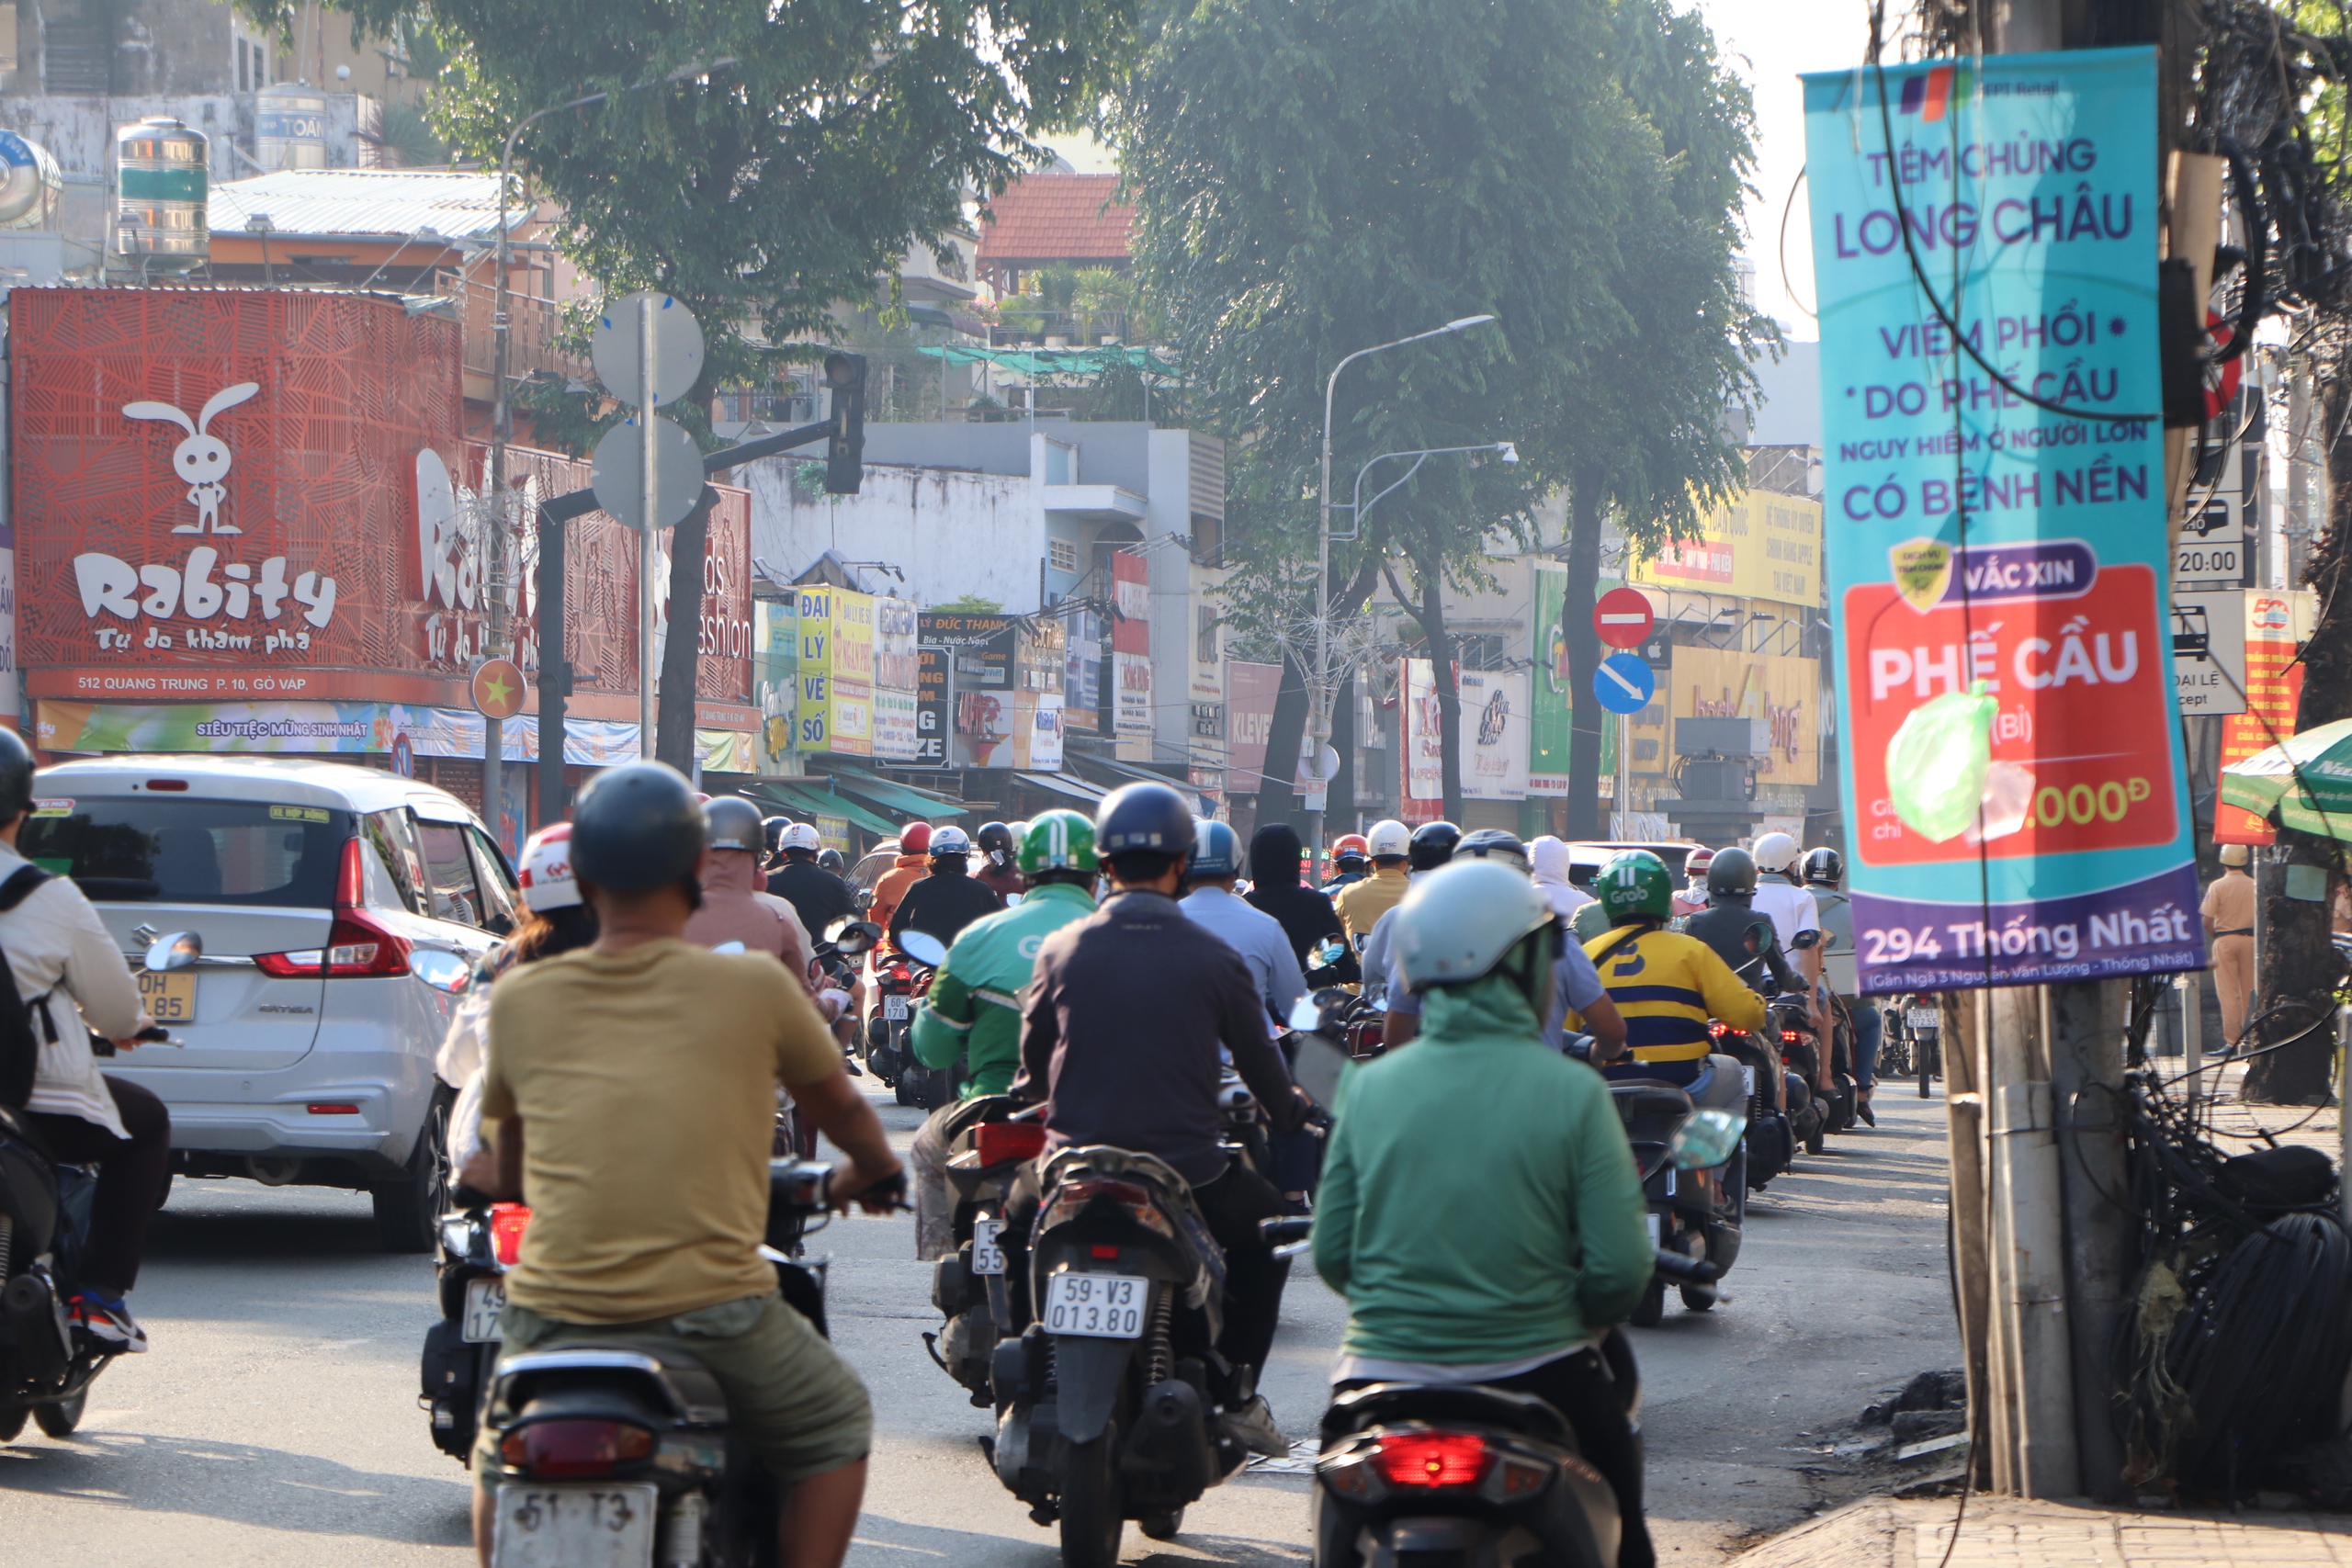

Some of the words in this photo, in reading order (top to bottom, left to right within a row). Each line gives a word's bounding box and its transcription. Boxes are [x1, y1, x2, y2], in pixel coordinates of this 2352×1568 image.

[2017, 80, 2059, 97] Retail
[1868, 141, 1951, 186] TÊM
[1962, 130, 2097, 178] CHỦNG
[1835, 201, 1978, 260] LONG
[1994, 181, 2133, 245] CHÂU
[1879, 313, 1984, 359] VIÊM
[1997, 299, 2096, 350] PHỔI
[1866, 382, 1928, 419] DO
[1942, 362, 2022, 412] PHẾ
[2032, 357, 2119, 408] CẦU
[1840, 438, 1909, 463] NGUY
[1917, 428, 1980, 457] HIỂM
[2012, 420, 2087, 449] NGƯỜI
[1844, 473, 1906, 521] CÓ
[1923, 467, 2041, 519] BỆNH
[2055, 455, 2148, 506] NỀN
[1965, 552, 2021, 591] VẮC
[2027, 559, 2075, 587] XIN
[2180, 551, 2236, 571] 20:00
[74, 546, 336, 628] Rabity
[801, 594, 830, 623] ĐẠI
[935, 616, 962, 630] ĐỨC
[95, 628, 131, 653] Tự
[143, 626, 172, 649] do
[187, 623, 251, 649] khám
[266, 625, 311, 654] phá
[697, 597, 752, 659] ashion
[923, 635, 937, 644] Bia
[944, 635, 967, 646] Nước
[804, 630, 825, 660] LÝ
[981, 651, 1006, 660] Game
[1871, 621, 2000, 700] PHẾ
[2014, 615, 2138, 689] CẦU
[78, 677, 100, 689] 512
[104, 677, 156, 690] QUANG
[160, 678, 209, 690] TRUNG
[216, 678, 228, 690] P.
[232, 678, 249, 692] 10,
[253, 674, 275, 690] GÒ
[805, 672, 826, 701] VÉ
[2200, 671, 2220, 688] LỆ
[2178, 694, 2208, 705] cept
[196, 719, 232, 737] SIÊU
[233, 719, 269, 739] TIỆC
[270, 719, 314, 737] MỪNG
[311, 723, 338, 737] SINH
[338, 720, 368, 740] NHẬT
[802, 710, 825, 742] SỐ
[1233, 712, 1274, 746] KLEVE
[2225, 747, 2239, 756] ANH
[2027, 777, 2151, 828] .000Đ
[1611, 886, 1648, 904] Grab
[1862, 926, 1941, 964] 294
[1949, 913, 2078, 960] Thống
[2089, 902, 2190, 948] Nhất
[1939, 971, 1949, 983] 3
[2103, 955, 2150, 974] Thống
[2154, 949, 2195, 968] Nhất)
[142, 998, 183, 1017] .85
[891, 998, 908, 1007] 60-
[978, 1248, 1003, 1269] 55
[482, 1282, 507, 1308] 49
[1065, 1278, 1133, 1304] 59-V3
[473, 1311, 501, 1337] 17
[1052, 1304, 1137, 1332] 013.80
